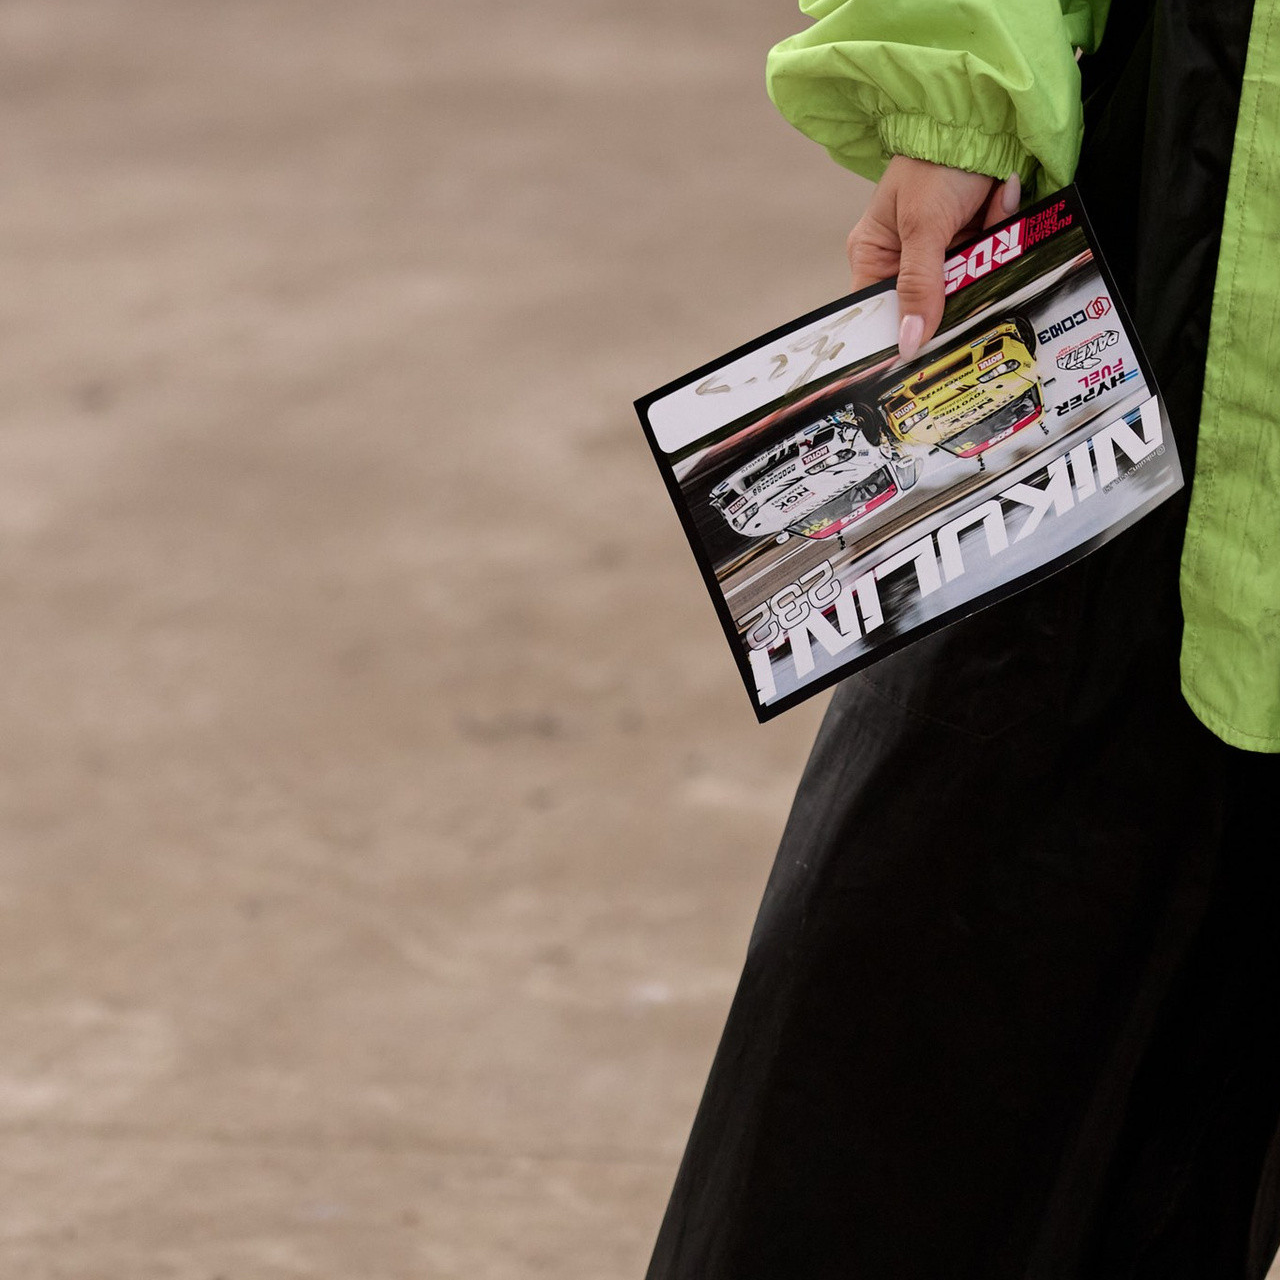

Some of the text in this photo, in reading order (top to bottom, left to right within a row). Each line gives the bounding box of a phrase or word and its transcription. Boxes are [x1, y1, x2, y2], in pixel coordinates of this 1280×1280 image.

[1027, 199, 1066, 227] SERIES
[1027, 213, 1057, 236] DRIFT
[1026, 213, 1072, 247] RUSSIAN
[941, 221, 1023, 295] RDS
[1036, 309, 1087, 345] СОЮЗ
[977, 352, 1003, 371] MOTUL
[1077, 356, 1123, 390] FUEL
[1054, 370, 1125, 418] HYPER
[893, 402, 914, 419] MOTUL
[803, 446, 828, 465] MOTUL
[727, 497, 746, 514] MOTUL
[775, 486, 810, 510] NGK
[734, 556, 843, 652] 232
